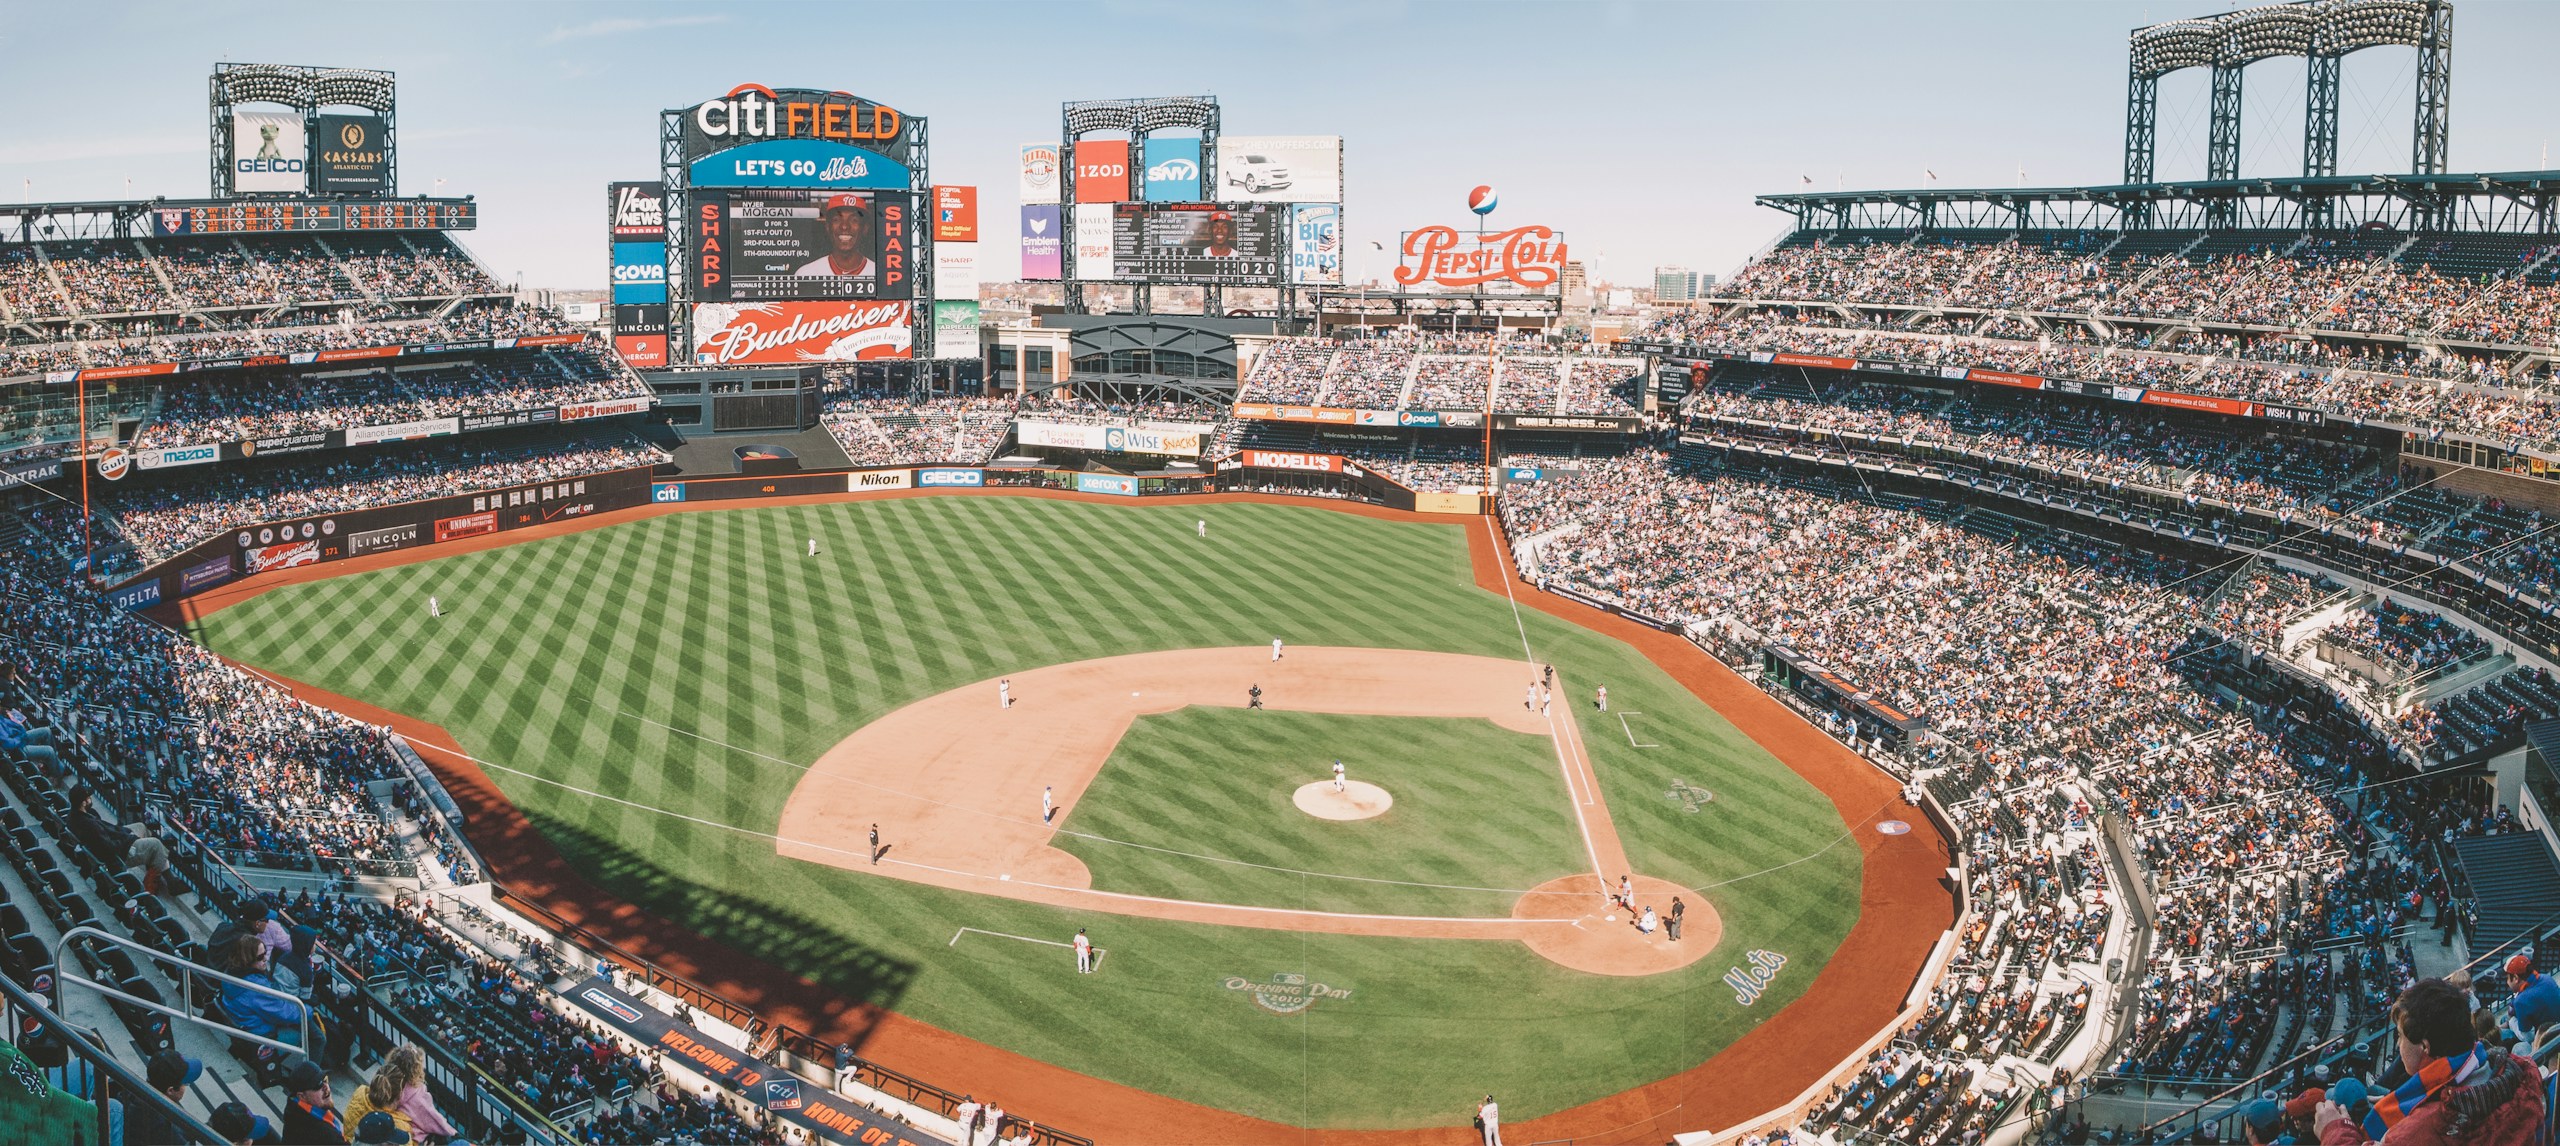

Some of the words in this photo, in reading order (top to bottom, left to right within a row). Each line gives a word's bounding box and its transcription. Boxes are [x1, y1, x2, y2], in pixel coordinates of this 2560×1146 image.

[697, 88, 777, 136] citi
[787, 102, 900, 139] FIELD
[1244, 139, 1335, 150] CHEVYOFFERS.COM
[323, 151, 383, 163] CAESARS
[237, 159, 303, 173] GEICO
[735, 159, 785, 176] LET'S
[790, 160, 816, 176] GO
[819, 155, 868, 181] Mets
[1079, 165, 1124, 178] IZOD
[1147, 165, 1192, 182] SNY
[630, 198, 662, 212] FOX
[621, 212, 663, 226] NEWS
[742, 208, 793, 217] MORGAN
[1299, 223, 1333, 240] BIG
[701, 204, 721, 288] SHARP
[885, 205, 903, 286] SHARP
[1022, 237, 1059, 246] Emblem
[1026, 246, 1056, 256] Health
[1294, 253, 1337, 267] BARS
[614, 264, 664, 281] GOYA
[1240, 262, 1249, 274] 0
[1254, 262, 1262, 274] 2
[1267, 262, 1275, 274] 0
[845, 283, 852, 293] 0
[856, 283, 864, 293] 2
[867, 283, 875, 293] 0
[617, 323, 665, 332] LINCOLN
[708, 303, 899, 363] Budweiser
[842, 332, 881, 353] American
[883, 331, 908, 343] Lager
[624, 352, 660, 361] MERCURY
[1870, 363, 1893, 371] IGARASHI
[1946, 367, 1959, 378] citi
[50, 373, 64, 382] citi
[2045, 380, 2054, 389] NL
[2117, 387, 2130, 400] citi
[2149, 394, 2159, 402] Enjoy
[2170, 396, 2193, 404] experience
[2206, 400, 2218, 408] Field.
[561, 405, 595, 420] BOB'S
[596, 403, 637, 415] FURNITURE
[1236, 407, 1271, 416] SUBWAY
[1273, 406, 1284, 419] $5
[1316, 411, 1352, 420] SUBWAY
[2266, 407, 2286, 419] WSH
[2286, 408, 2292, 419] 4
[2298, 411, 2311, 421] NY
[2314, 412, 2320, 423] 3
[464, 418, 482, 426] Watch
[516, 414, 529, 423] Bat
[1412, 414, 1437, 425] pepsi
[1457, 418, 1477, 426] max
[355, 428, 386, 439] Alliance
[387, 425, 418, 435] Building
[420, 422, 451, 432] Services
[1323, 431, 1350, 439] Welcome
[256, 432, 327, 448] superguarantee
[1051, 437, 1085, 446] DONUTS
[1127, 432, 1158, 449] WISE
[1163, 434, 1197, 451] SNACKS
[163, 448, 214, 463] mazda
[1253, 452, 1330, 471] MODELL'S
[101, 456, 126, 473] Gulf
[1230, 460, 1242, 469] Zone
[0, 465, 58, 487] AMTRAK
[921, 471, 980, 485] GEICO
[1351, 467, 1363, 477] Zone
[860, 474, 899, 486] Nikon
[1084, 478, 1119, 490] xerox
[656, 486, 679, 501] citi
[762, 485, 775, 493] 408
[566, 503, 594, 515] verizon
[450, 517, 472, 530] UNION
[519, 515, 531, 523] 384
[263, 532, 270, 540] 14
[284, 529, 291, 537] 41
[304, 526, 312, 534] 42
[241, 535, 249, 544] 37
[357, 530, 417, 548] LINCOLN
[250, 540, 316, 572] Budweiser
[324, 547, 339, 556] 371
[119, 585, 160, 609] DELTA
[1722, 948, 1788, 1006] Mets
[1222, 976, 1301, 995] OPENING
[1309, 982, 1353, 1000] DAY
[586, 989, 637, 1021] mets.com
[1270, 994, 1303, 1004] 2010
[659, 1029, 739, 1074] WELCOME
[733, 1066, 764, 1087] TO
[767, 1081, 794, 1097] citi
[770, 1099, 799, 1109] FIELD
[803, 1101, 865, 1136] HOME
[861, 1126, 894, 1146] OF
